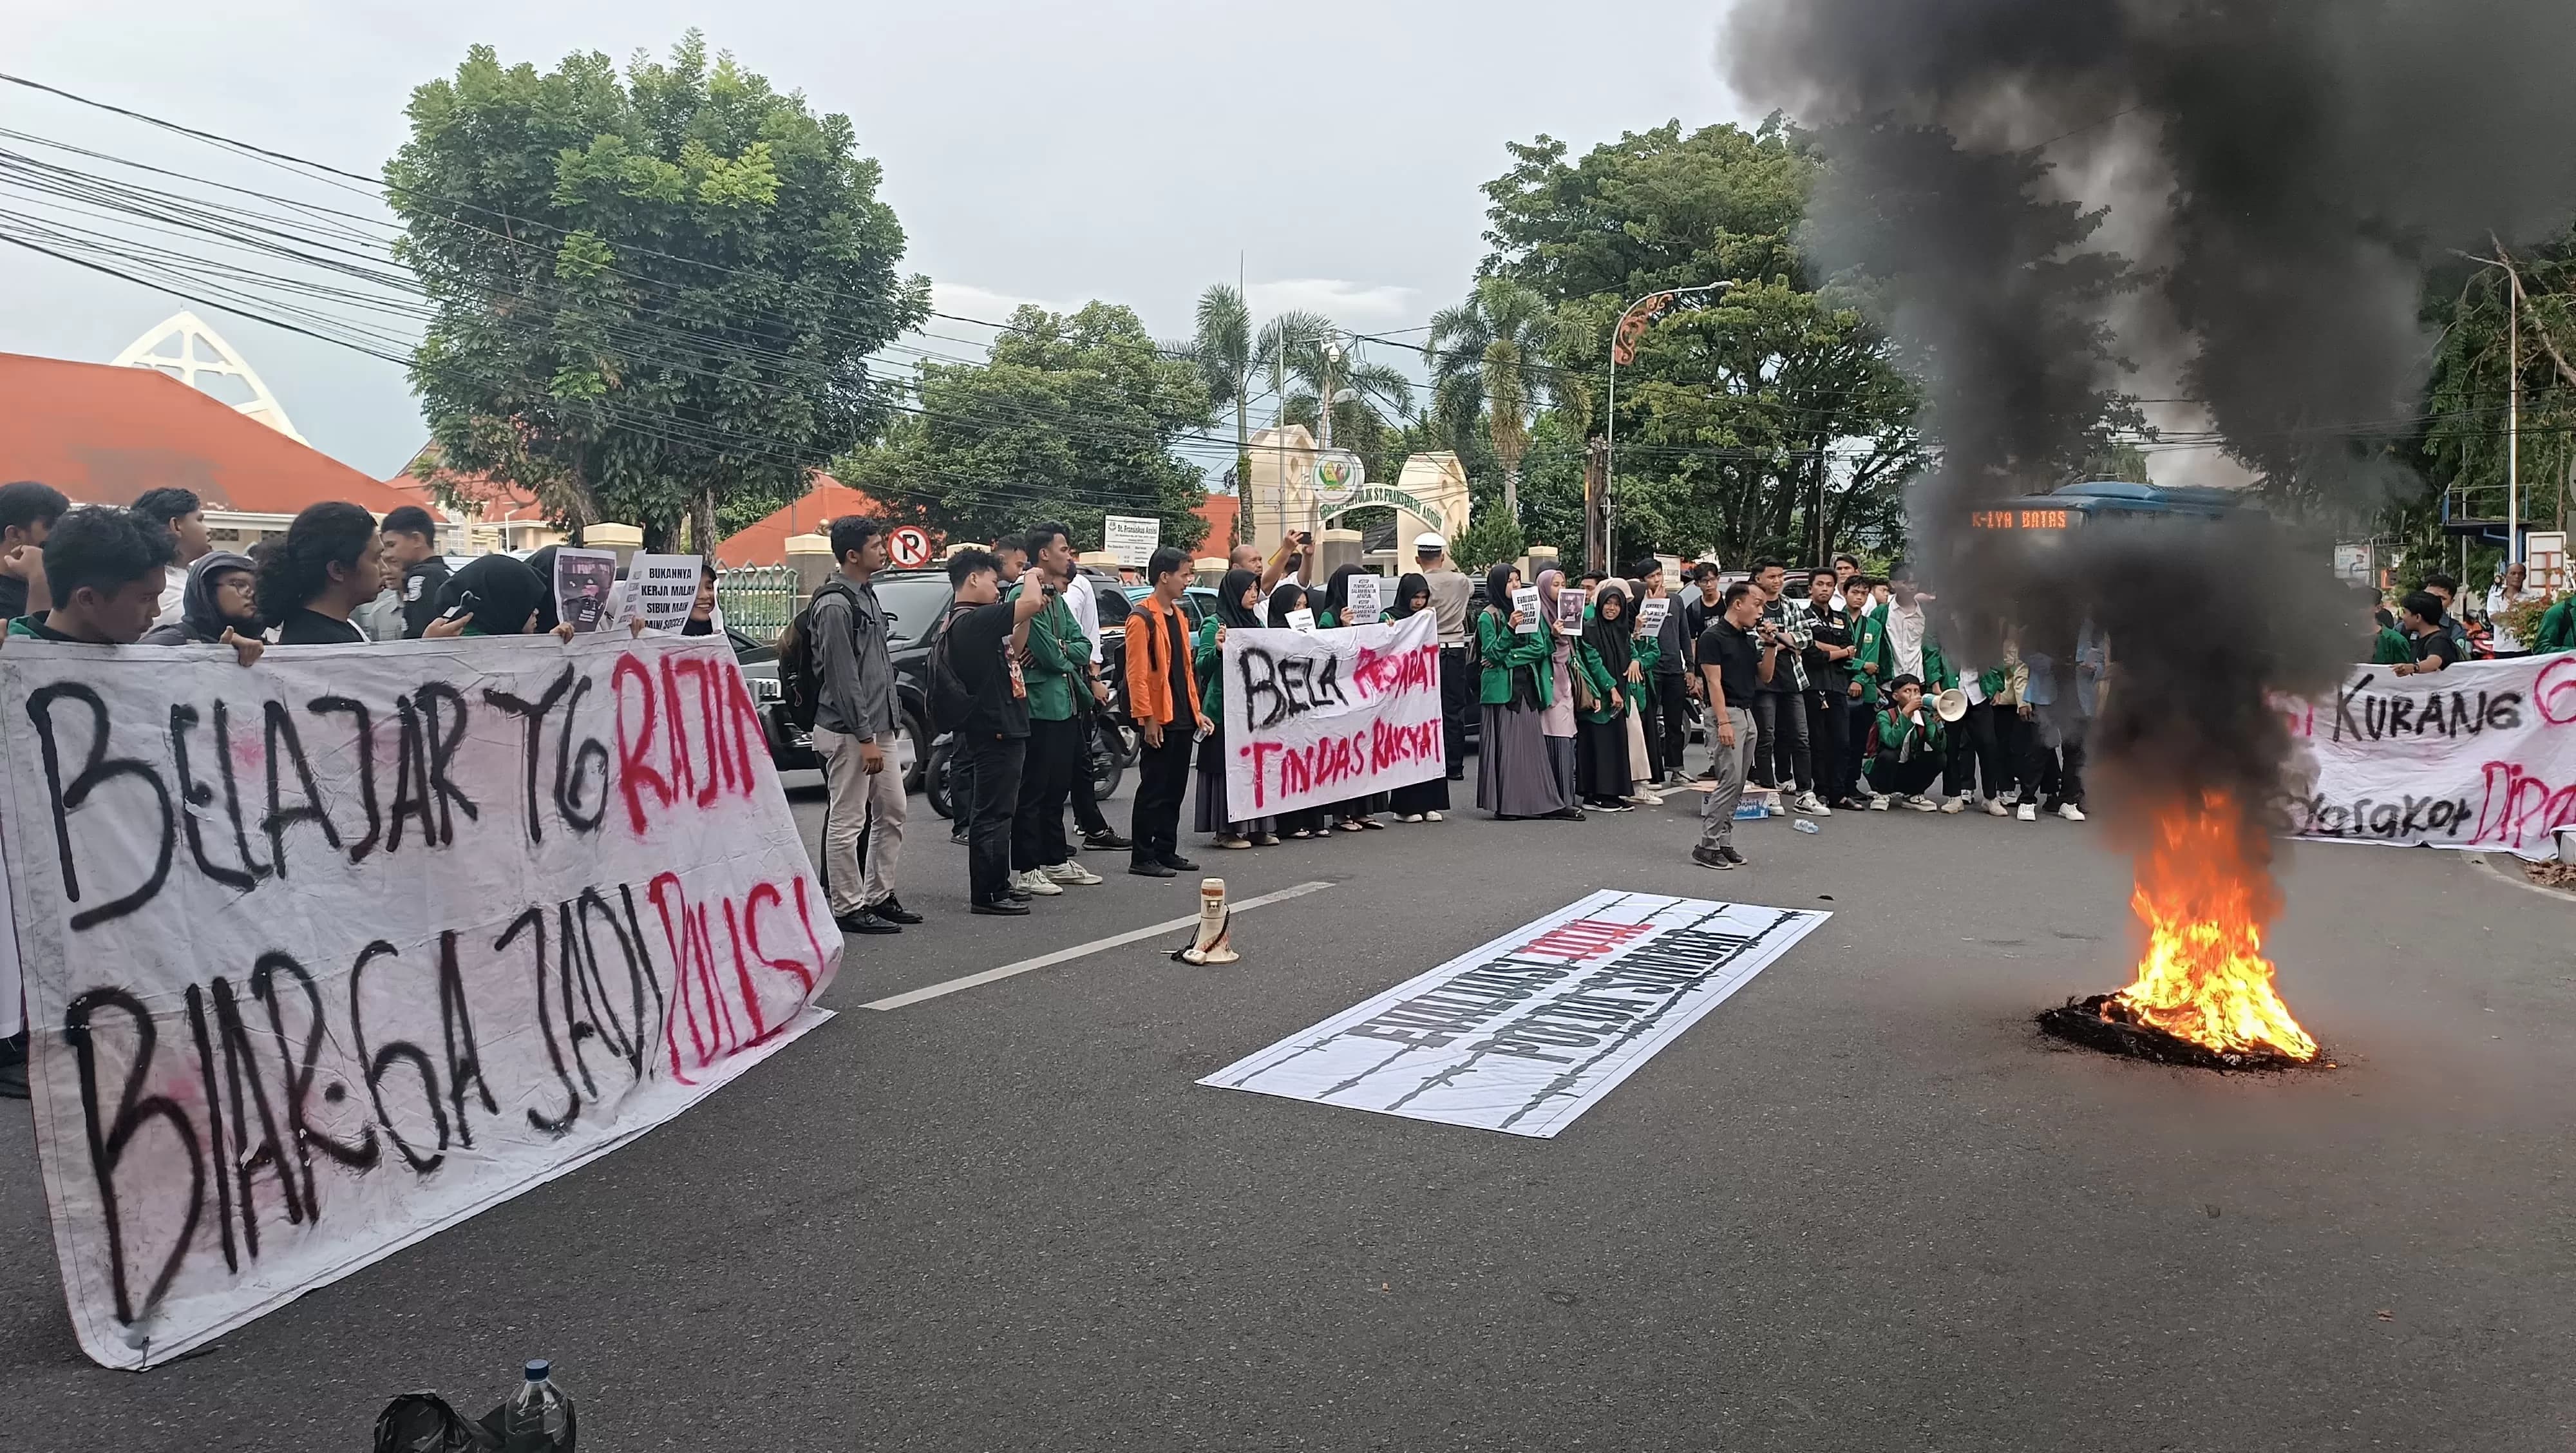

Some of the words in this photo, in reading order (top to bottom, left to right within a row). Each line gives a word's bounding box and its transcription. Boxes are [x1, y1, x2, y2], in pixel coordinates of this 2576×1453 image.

[641, 585, 668, 596] KERJA
[671, 585, 696, 596] MALAH
[647, 603, 670, 614] SIBUK
[672, 602, 689, 613] MAIN
[649, 568, 692, 579] BUKANNYA
[1517, 594, 1538, 604] EVALUASI
[1522, 603, 1535, 611] TOTAL
[1238, 647, 1349, 733] BELA
[2333, 673, 2524, 742] KURANG
[1240, 730, 1366, 809] TINDAS
[1371, 717, 1441, 776] RAKYAT
[26, 681, 478, 932] BELAJAR
[1343, 957, 1582, 1050] EVALUASI
[1520, 918, 1656, 960] TOTAL
[1465, 992, 1657, 1064] POLDA
[1578, 929, 1751, 995] SUMBAR
